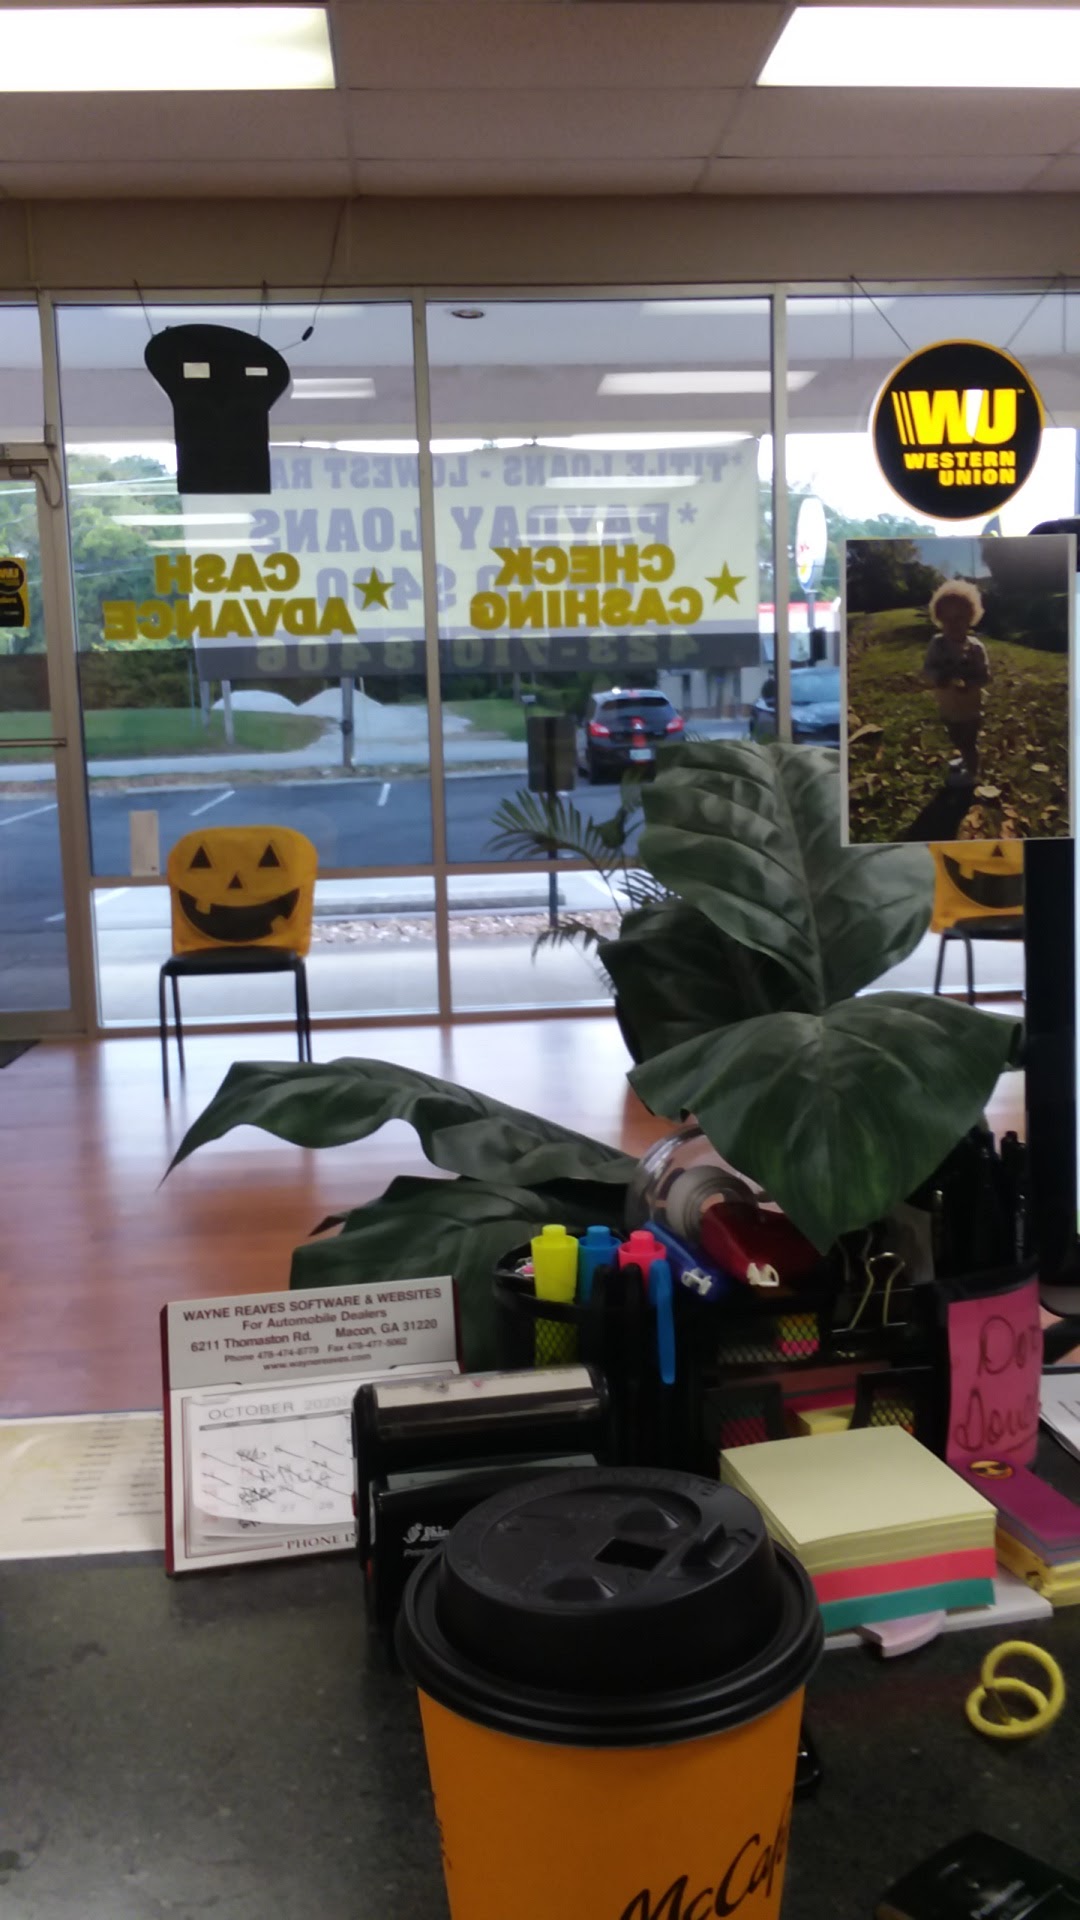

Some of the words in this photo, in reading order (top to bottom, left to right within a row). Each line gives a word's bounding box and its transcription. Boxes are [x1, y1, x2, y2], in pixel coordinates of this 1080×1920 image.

[891, 388, 1018, 446] WU
[903, 450, 1017, 470] WESTERN
[938, 467, 1017, 487] UNION
[183, 1307, 232, 1322] WAYNE
[234, 1302, 286, 1317] REAVES
[289, 1295, 361, 1312] SOFTWARE
[364, 1294, 374, 1305] &
[376, 1287, 442, 1304] WEBSITES
[242, 1320, 263, 1331] For
[267, 1313, 337, 1328] Automobile
[340, 1309, 388, 1322] Dealers
[190, 1340, 219, 1353] 6211
[223, 1334, 290, 1349] Thomaston
[293, 1330, 312, 1342] Rd.
[380, 1322, 400, 1334] GA
[403, 1318, 438, 1332] 31220
[224, 1353, 255, 1363] Phone
[327, 1343, 344, 1353] Fax
[208, 1401, 295, 1421] OCTOBER
[286, 1534, 339, 1550] PHONE
